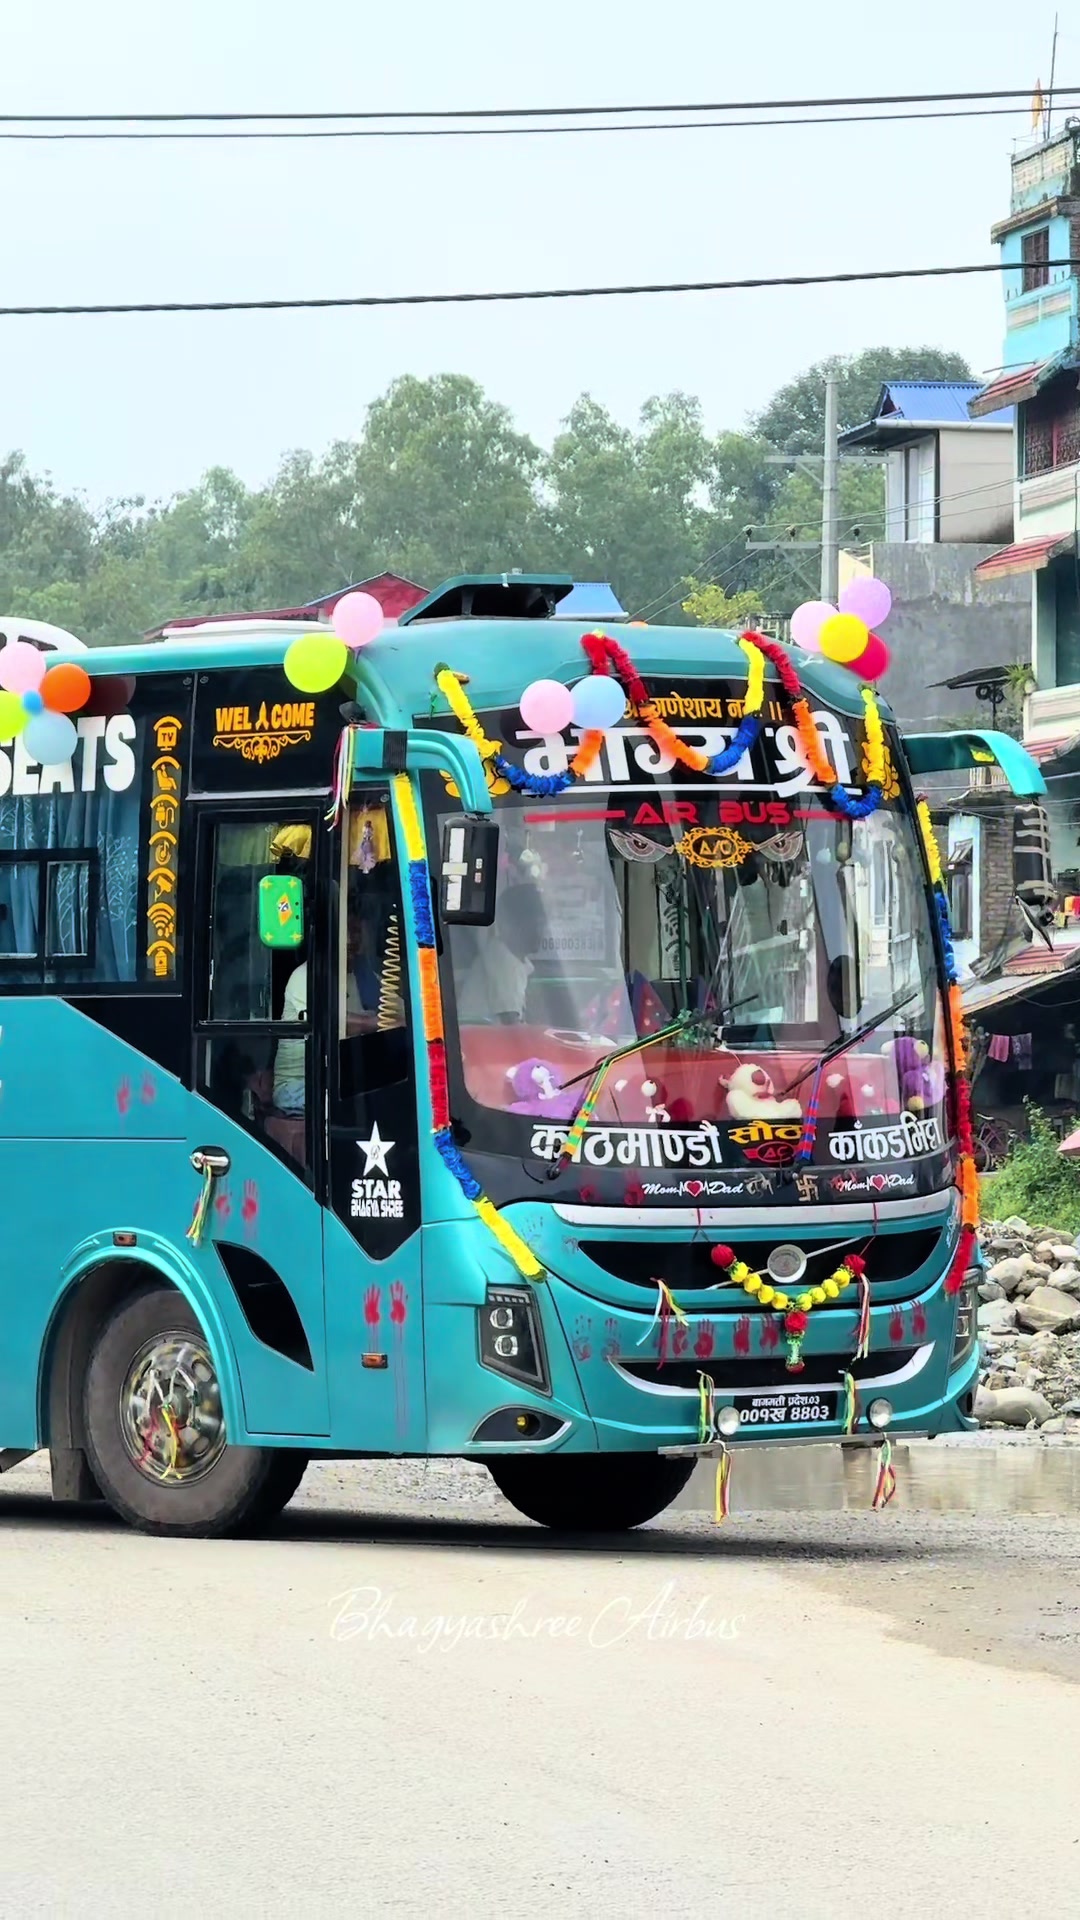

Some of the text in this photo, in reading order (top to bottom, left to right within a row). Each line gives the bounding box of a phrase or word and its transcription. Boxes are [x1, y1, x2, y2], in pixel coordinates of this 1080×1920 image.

[161, 732, 174, 742] TV
[0, 714, 136, 797] ETS
[633, 801, 791, 824] AIR BUS
[700, 840, 732, 855] A/C
[763, 1146, 792, 1160] AC
[351, 1179, 402, 1199] STAR
[642, 1183, 679, 1195] Mom
[709, 1181, 743, 1194] Dad
[837, 1174, 914, 1192] Mom Dad
[380, 1200, 404, 1217] SHREE
